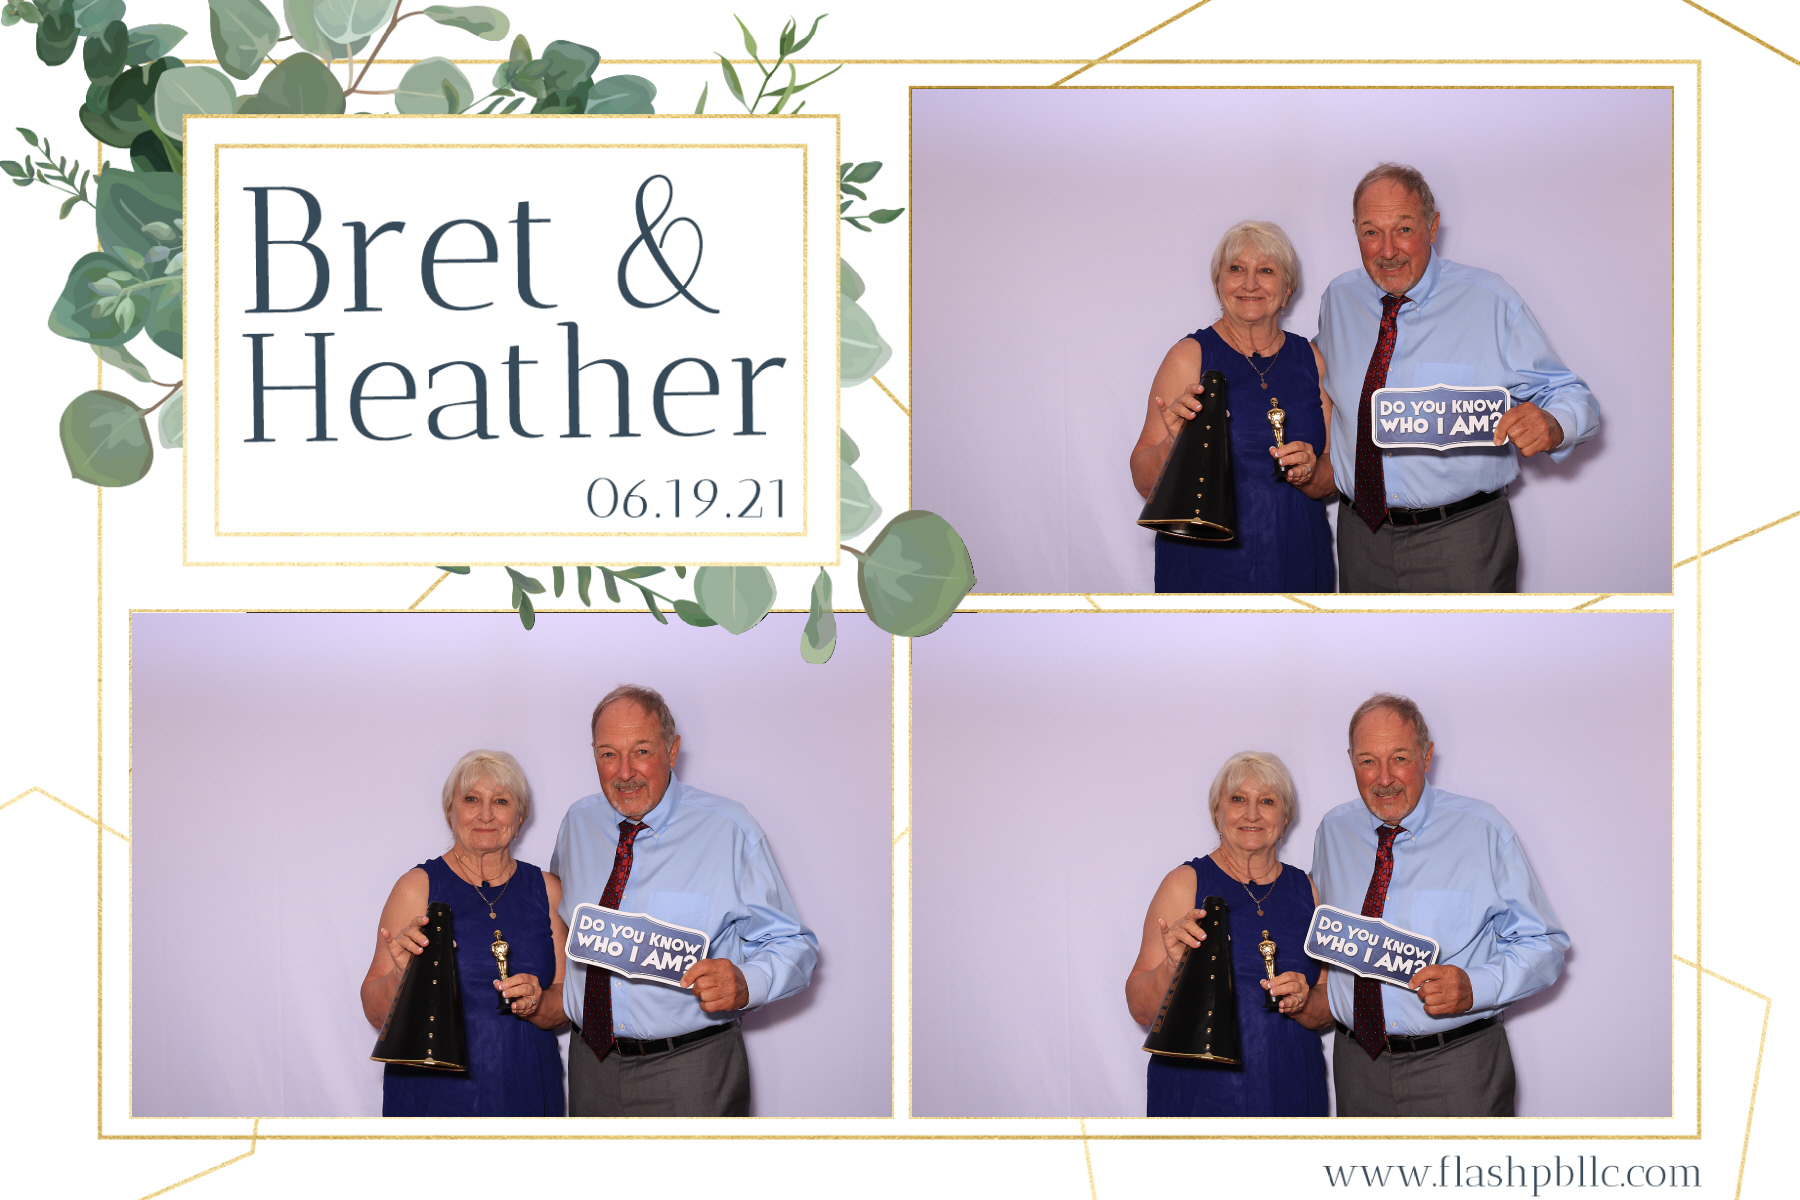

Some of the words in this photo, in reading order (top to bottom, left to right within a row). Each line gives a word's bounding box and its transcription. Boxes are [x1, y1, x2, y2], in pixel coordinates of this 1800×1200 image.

[1380, 400, 1406, 416] DO
[1410, 399, 1446, 416] YOU
[1452, 399, 1503, 415] KNOW
[1380, 416, 1429, 434] WHO
[1437, 417, 1444, 435] I
[1449, 412, 1503, 436] AM?
[577, 931, 624, 957] WHO
[629, 945, 639, 963] I
[640, 949, 698, 975] AM?
[579, 915, 605, 932] DO
[610, 922, 646, 944] YOU
[649, 932, 702, 956] KNOW
[1315, 931, 1359, 957] WHO
[1363, 947, 1373, 964] I
[1318, 915, 1343, 933] DO
[1347, 924, 1380, 946] YOU
[1382, 936, 1432, 960] KNOW
